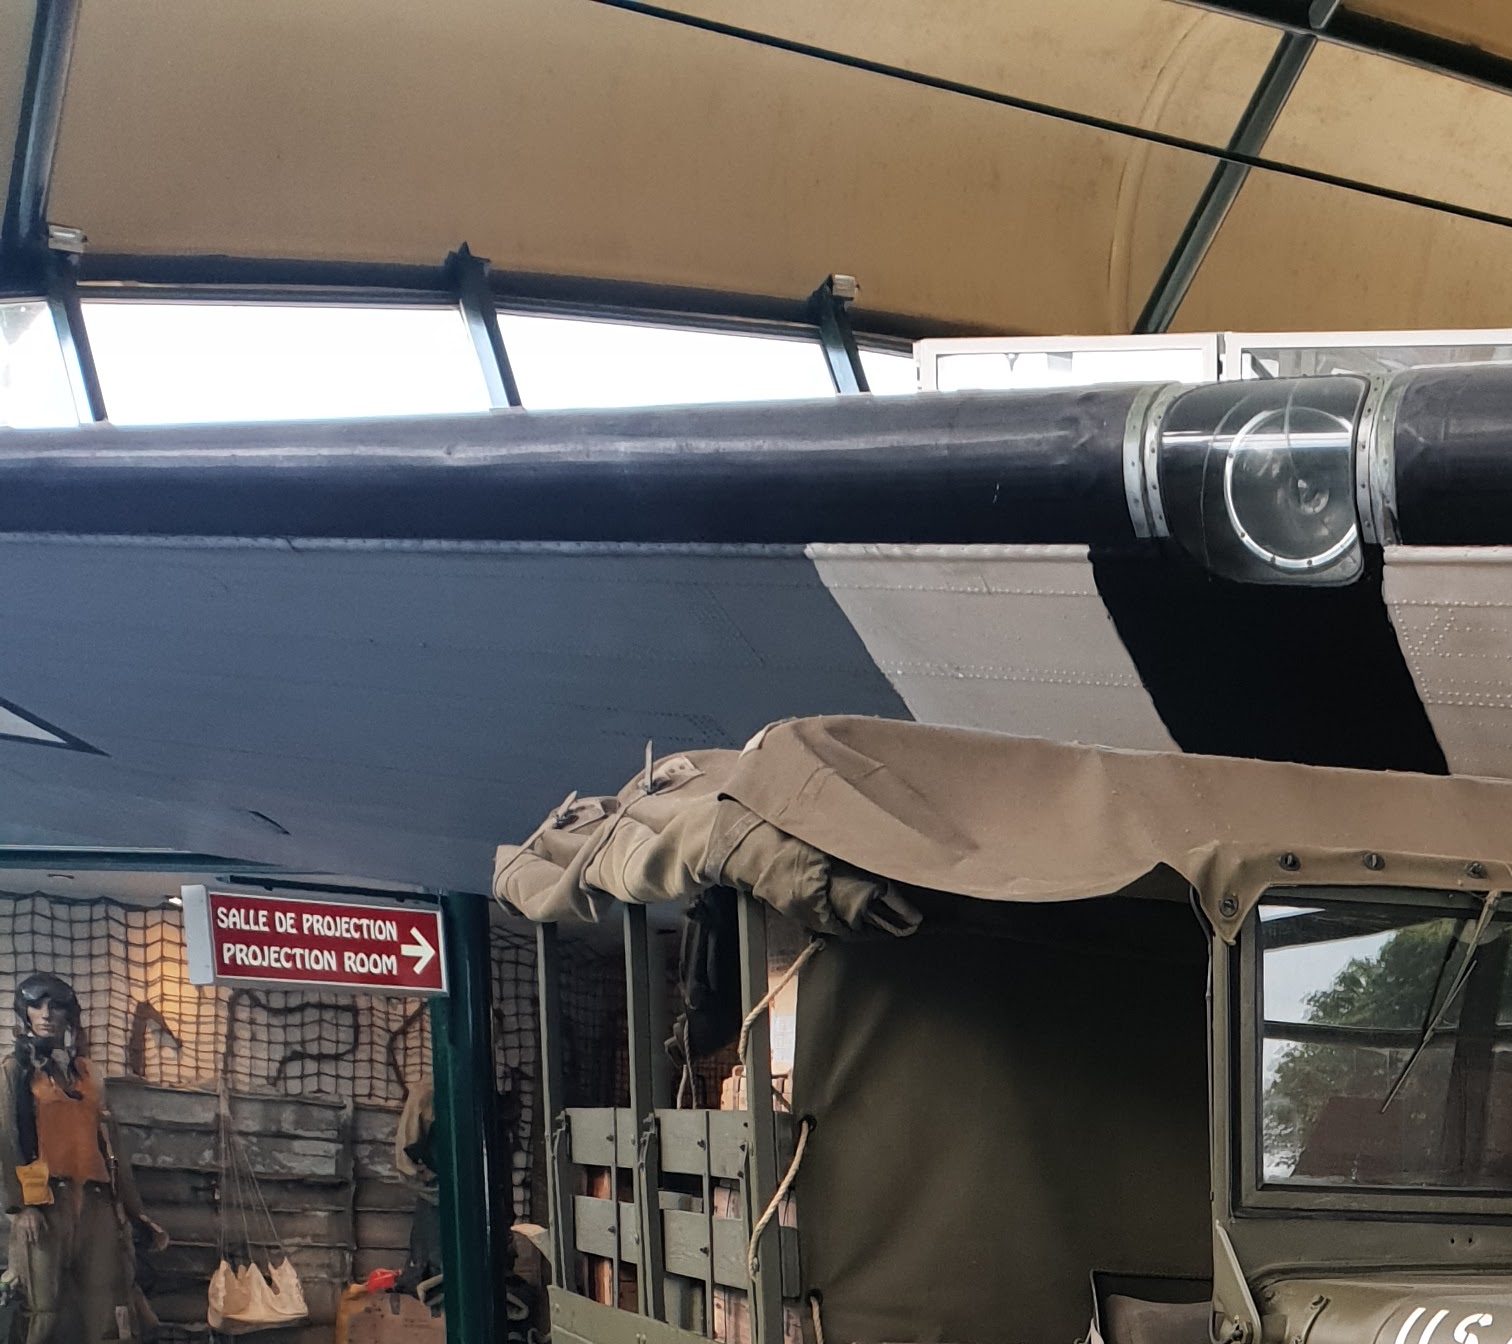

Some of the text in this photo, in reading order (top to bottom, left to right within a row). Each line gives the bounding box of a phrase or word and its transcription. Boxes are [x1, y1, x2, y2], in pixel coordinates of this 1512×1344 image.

[217, 906, 398, 942] SALLE DE PROJECTION
[222, 943, 398, 976] PROJECTION ROOM
